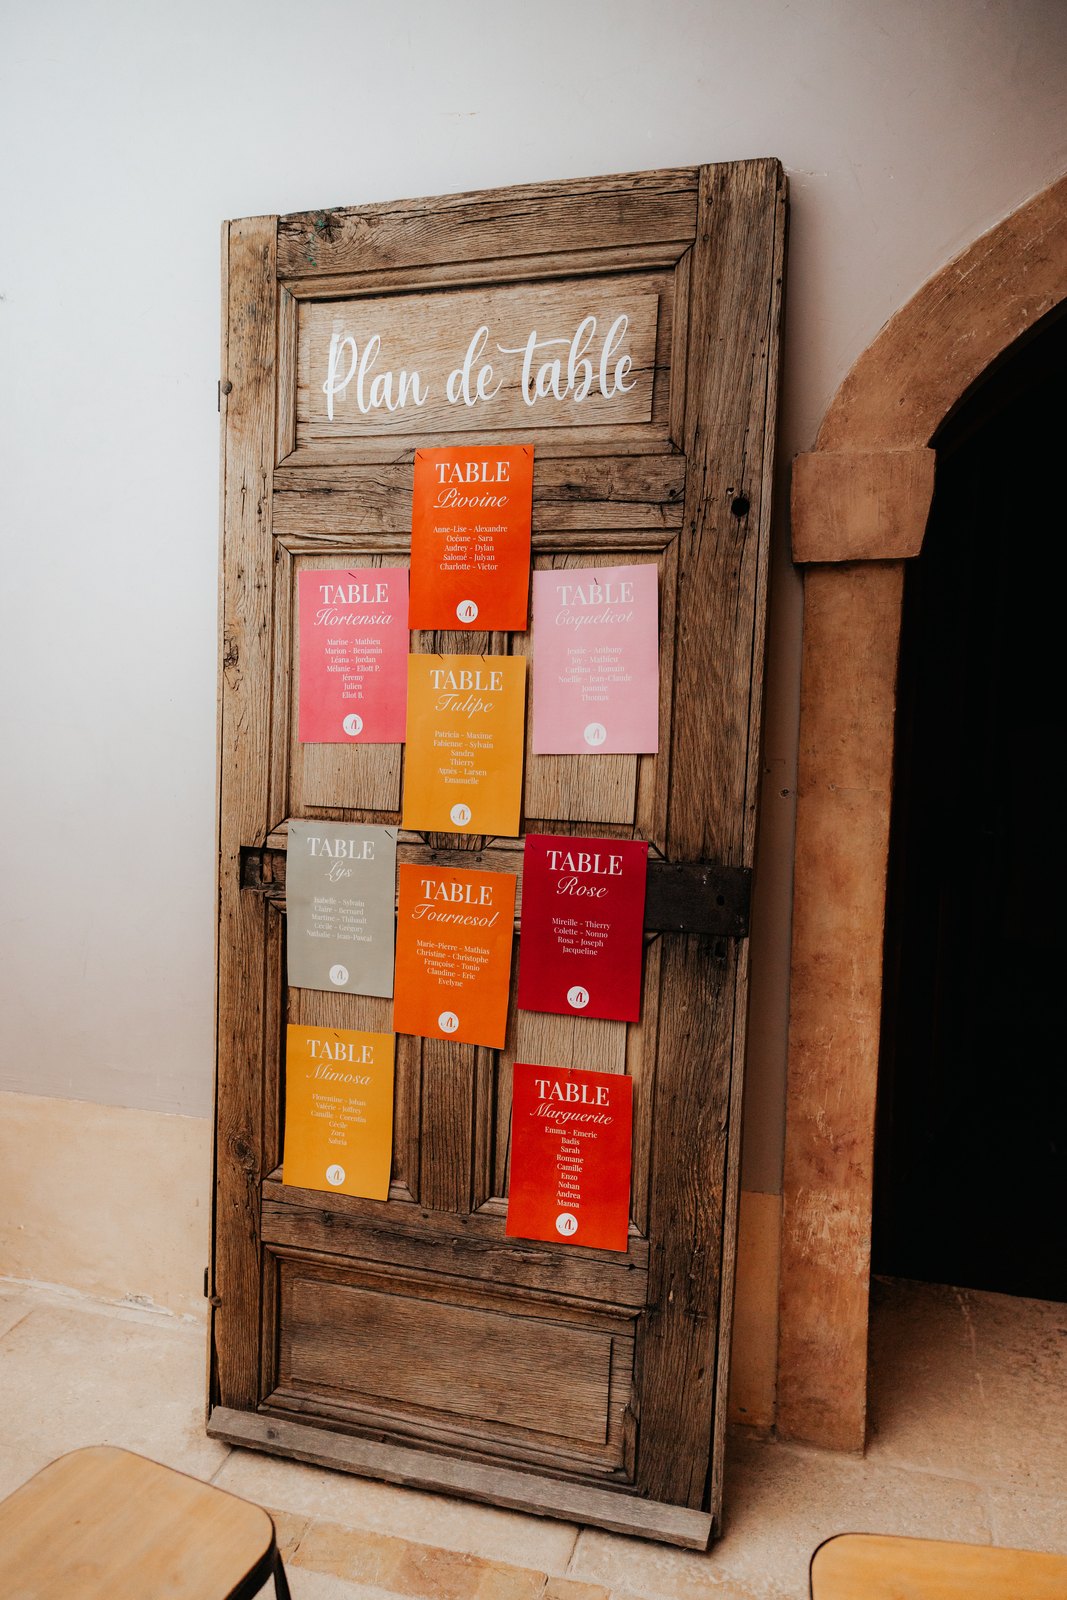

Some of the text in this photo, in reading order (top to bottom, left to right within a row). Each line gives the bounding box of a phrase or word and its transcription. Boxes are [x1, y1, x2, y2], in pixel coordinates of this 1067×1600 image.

[322, 315, 637, 421] Plan de table
[436, 462, 509, 483] TABLE
[433, 488, 509, 508] Pivoine
[320, 584, 388, 604] TABLE
[557, 582, 634, 606] TABLE
[314, 608, 393, 626] Hortensia
[555, 608, 633, 631] Coquelicot
[430, 670, 503, 691] TABLE
[434, 694, 495, 719] Tulipe
[470, 741, 493, 749] Sylvain
[450, 758, 474, 767] Thierry
[307, 837, 375, 860] TABLE
[325, 860, 353, 883] Lys
[546, 850, 623, 876] TABLE
[421, 880, 493, 906] TABLE
[556, 876, 608, 898] Rose
[412, 904, 500, 928] Tournesol
[552, 918, 578, 926] Mireille
[585, 921, 610, 930] Thierry
[416, 940, 457, 951] Marie-Pierre
[464, 946, 490, 955] Mathias
[562, 946, 598, 956] Jacqueline
[581, 939, 604, 947] Joseph
[416, 949, 446, 958] Christine
[453, 954, 488, 964] Christophe
[424, 959, 454, 969] Françoise
[462, 963, 480, 971] Tonio
[427, 968, 456, 977] Claudine
[438, 978, 463, 987] Evelyne
[307, 1039, 374, 1064] TABLE
[306, 1064, 372, 1085] Mimosa
[535, 1080, 610, 1107] TABLE
[529, 1103, 614, 1125] Marguerite
[545, 1126, 566, 1135] Emma
[573, 1129, 598, 1139] Emeric
[556, 1155, 584, 1163] Romane
[560, 1146, 580, 1154] Sarah
[557, 1164, 582, 1172] Camille
[556, 1191, 581, 1199] Andrea
[558, 1181, 580, 1190] Nohan
[557, 1200, 579, 1208] Manoa
